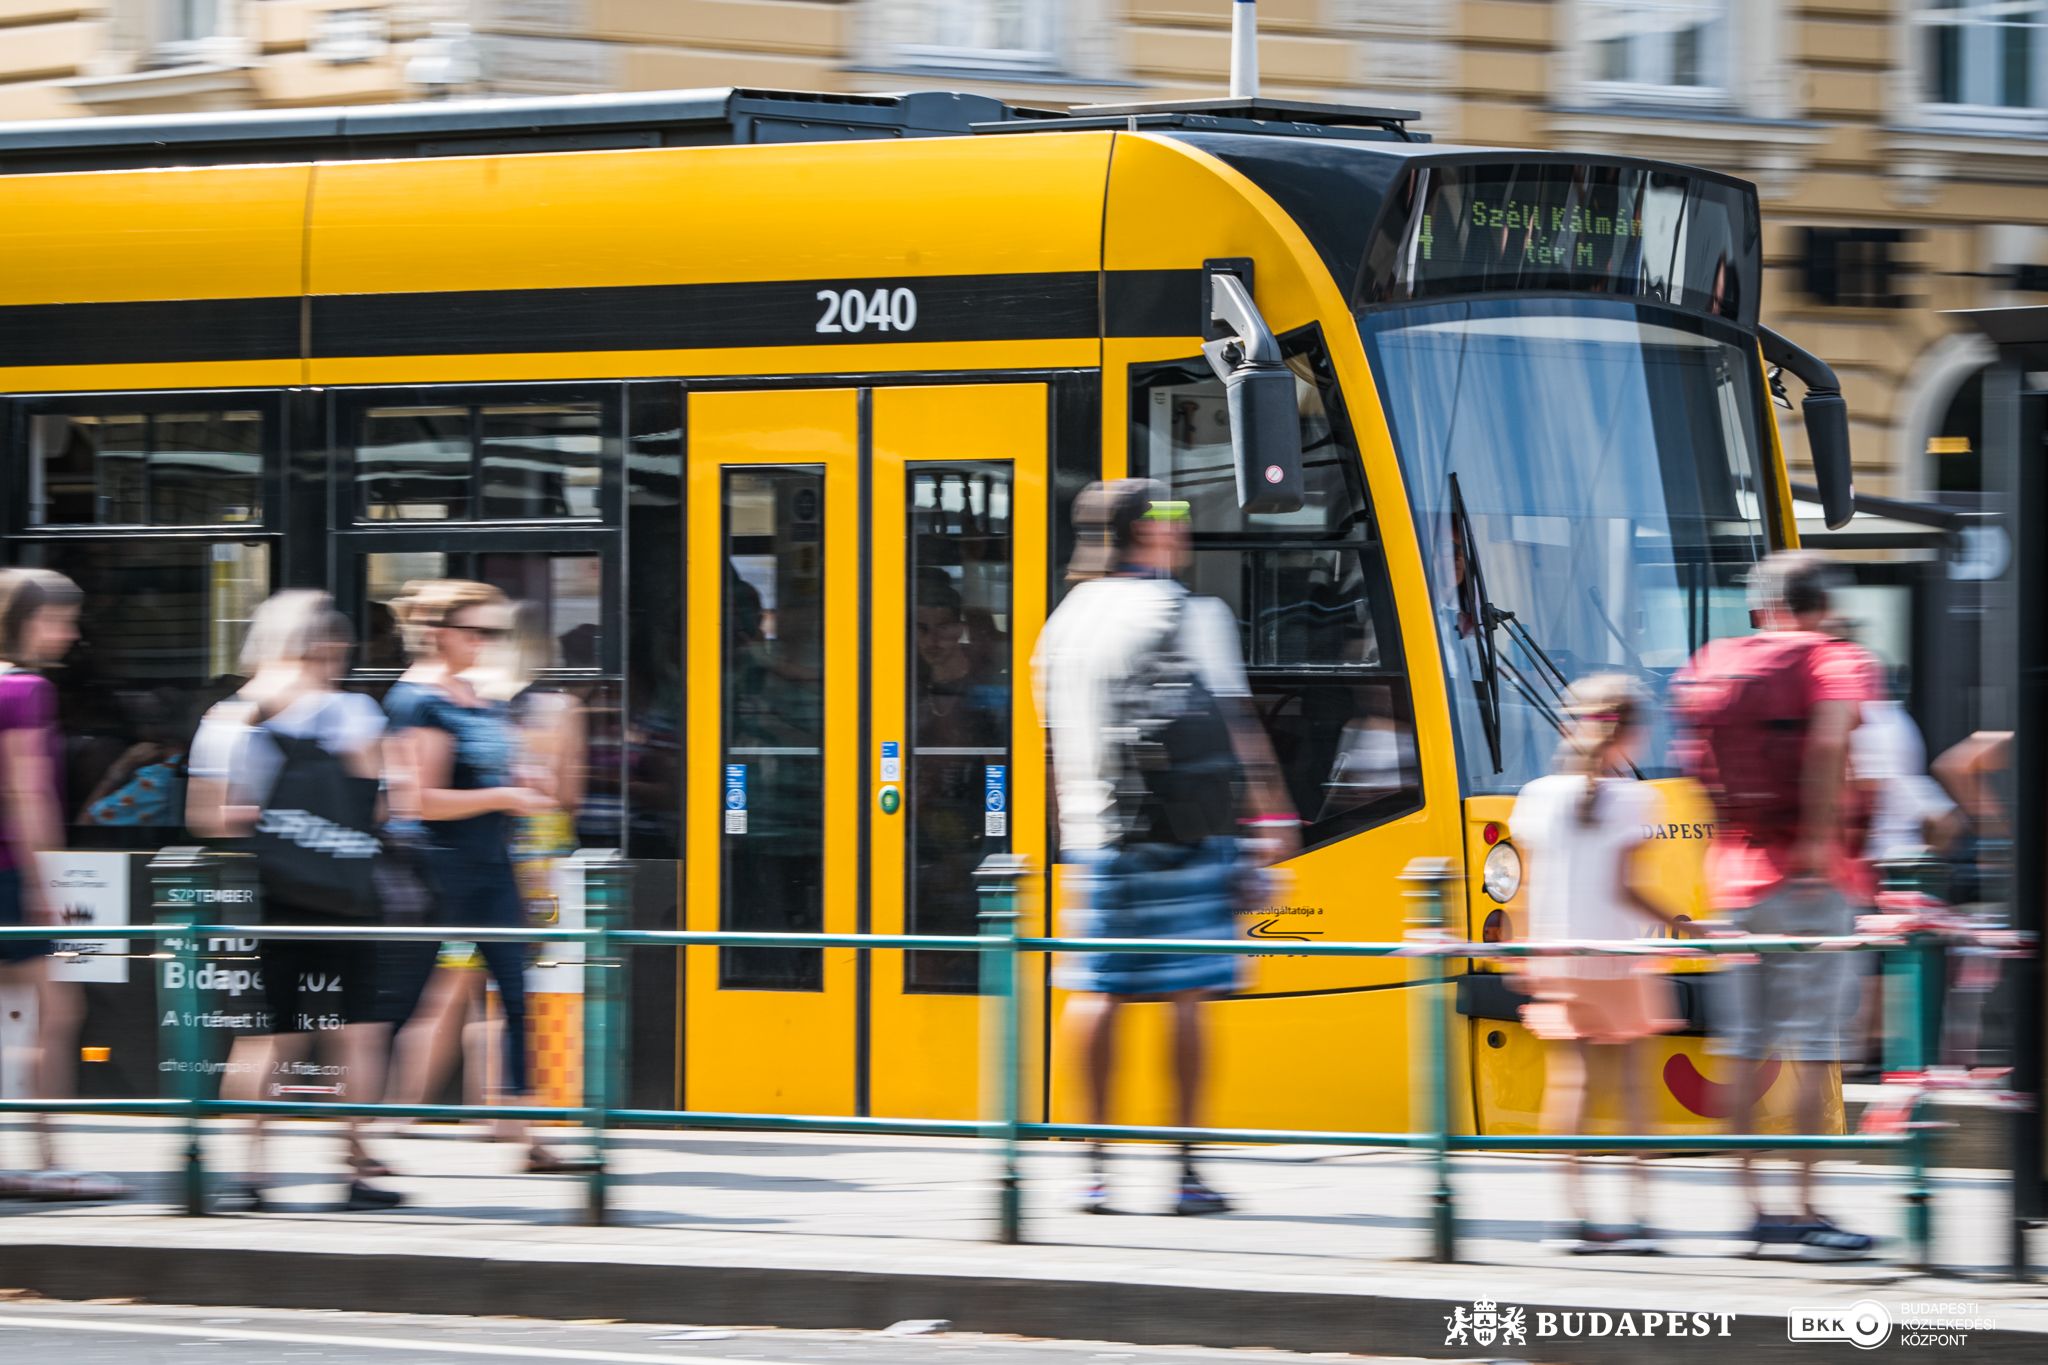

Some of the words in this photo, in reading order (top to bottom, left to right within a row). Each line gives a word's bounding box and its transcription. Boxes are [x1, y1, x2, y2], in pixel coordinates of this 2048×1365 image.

[1418, 214, 1434, 260] 4
[1472, 201, 1541, 231] Széll
[1552, 205, 1644, 237] Kálmán
[1525, 236, 1566, 265] tér
[1577, 242, 1593, 267] M
[816, 287, 917, 333] 2040
[1642, 823, 1715, 839] DAPEST
